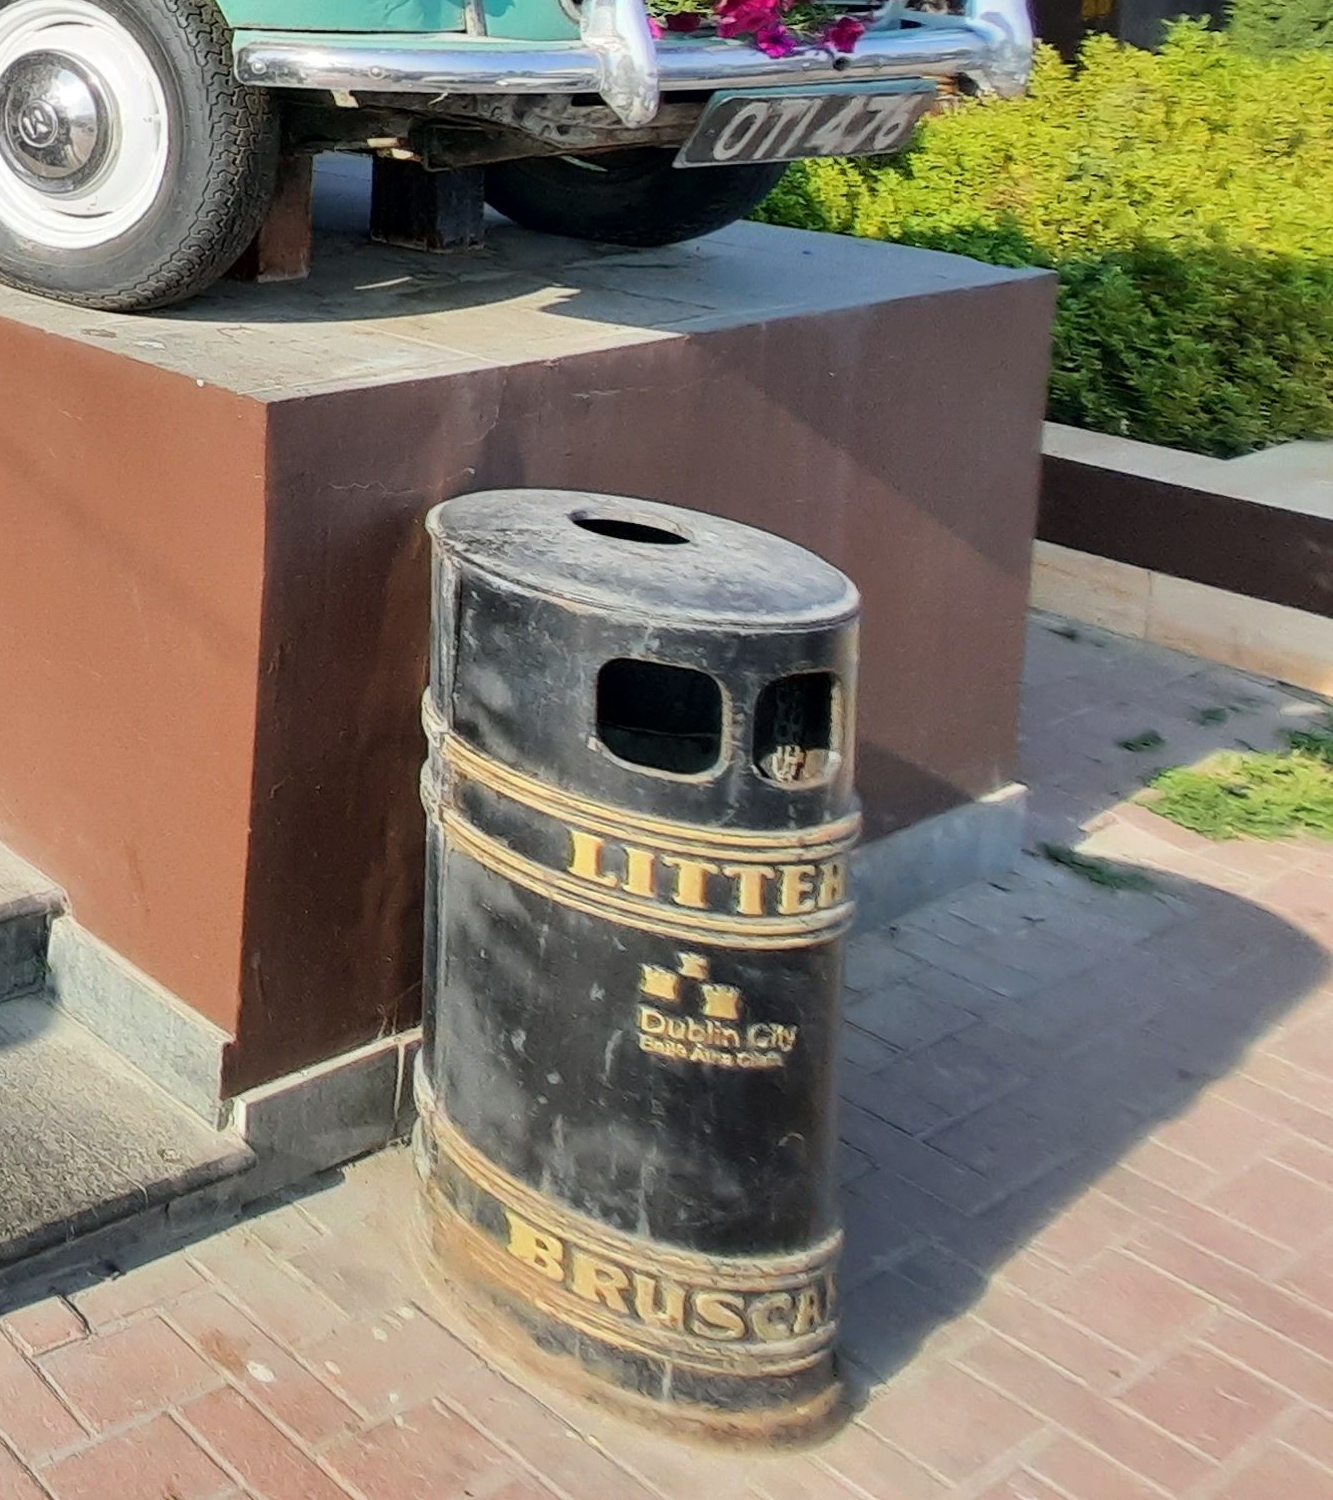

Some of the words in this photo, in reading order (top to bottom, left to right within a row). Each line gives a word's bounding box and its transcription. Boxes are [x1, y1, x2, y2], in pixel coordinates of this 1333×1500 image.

[637, 1005, 741, 1049] Dublin
[746, 1022, 800, 1053] City
[506, 1209, 837, 1342] BRUSCA
